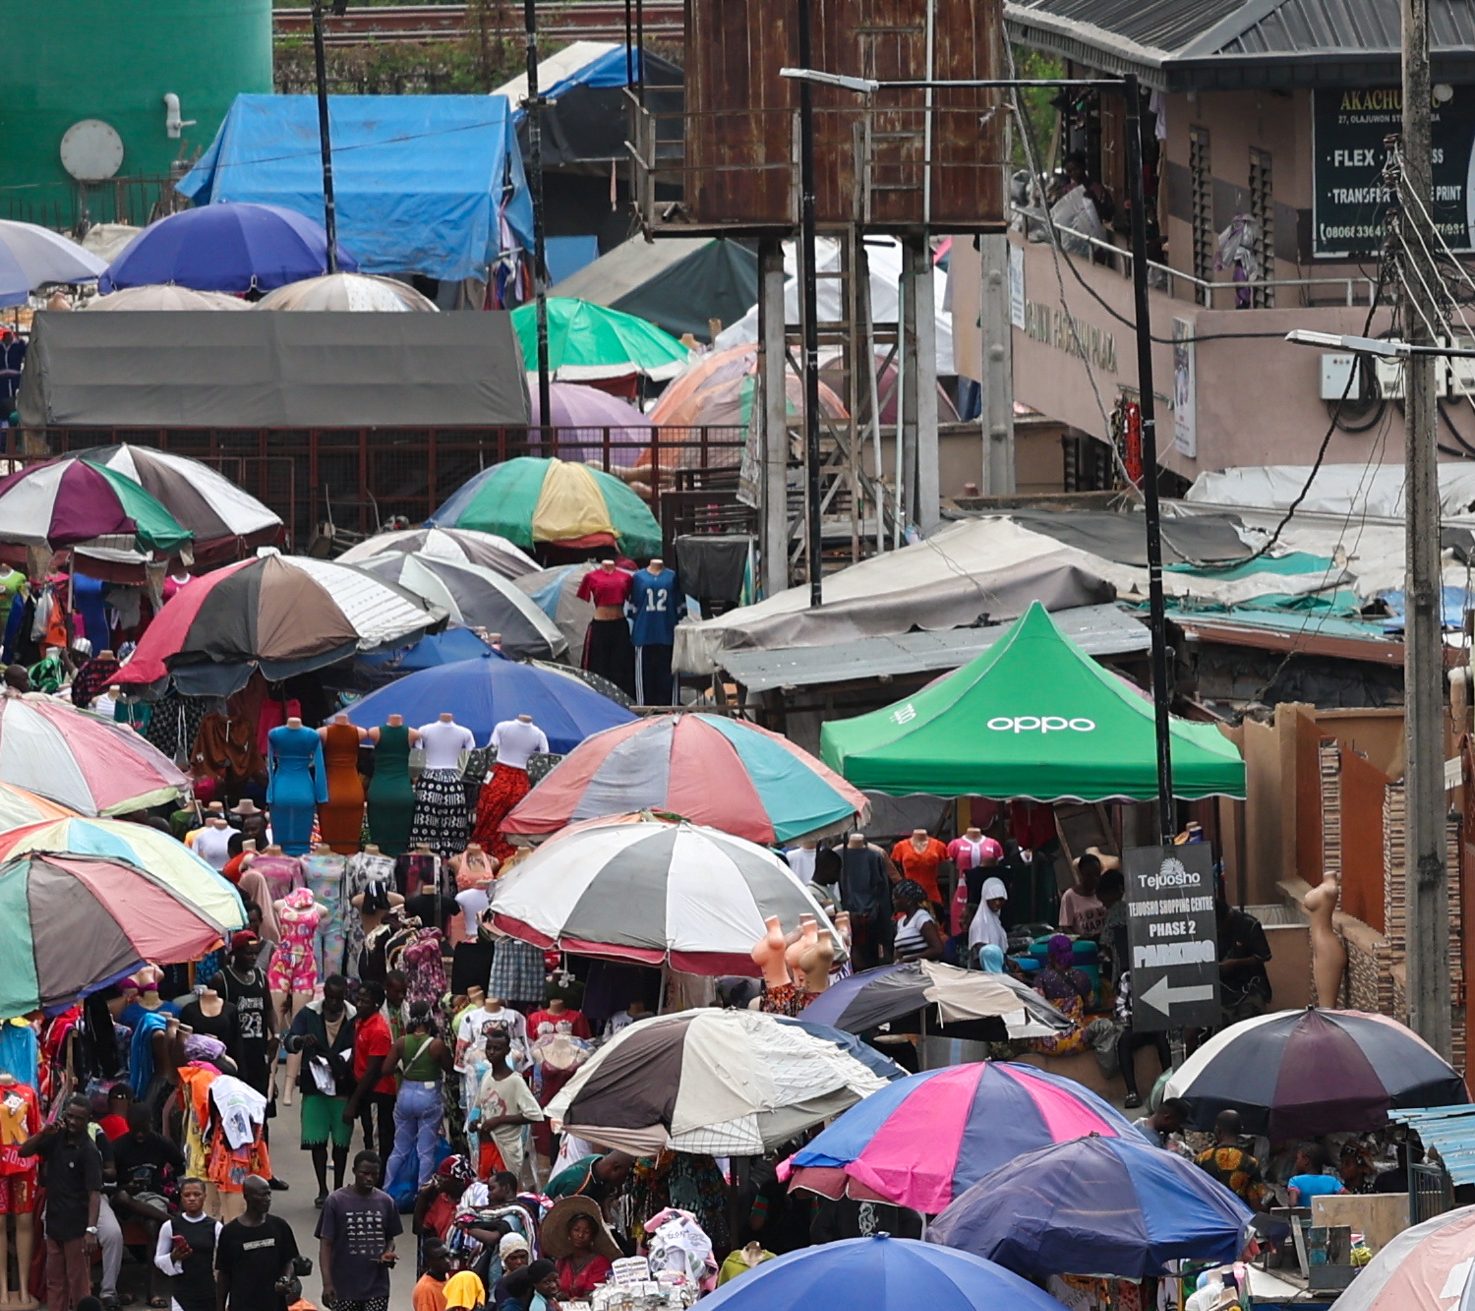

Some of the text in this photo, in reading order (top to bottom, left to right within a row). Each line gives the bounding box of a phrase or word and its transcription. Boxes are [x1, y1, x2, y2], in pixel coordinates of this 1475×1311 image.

[1341, 89, 1441, 110] AKACHU
[1333, 150, 1375, 167] FLEX
[1436, 186, 1462, 201] PRINT
[646, 588, 668, 612] 12
[987, 716, 1096, 733] oppo
[1137, 872, 1201, 890] Tejuosho
[1128, 896, 1214, 917] TEJUOSHO SHOPPING CENTRE
[1149, 920, 1197, 937] PHASE 2
[1133, 939, 1216, 968] PARKING
